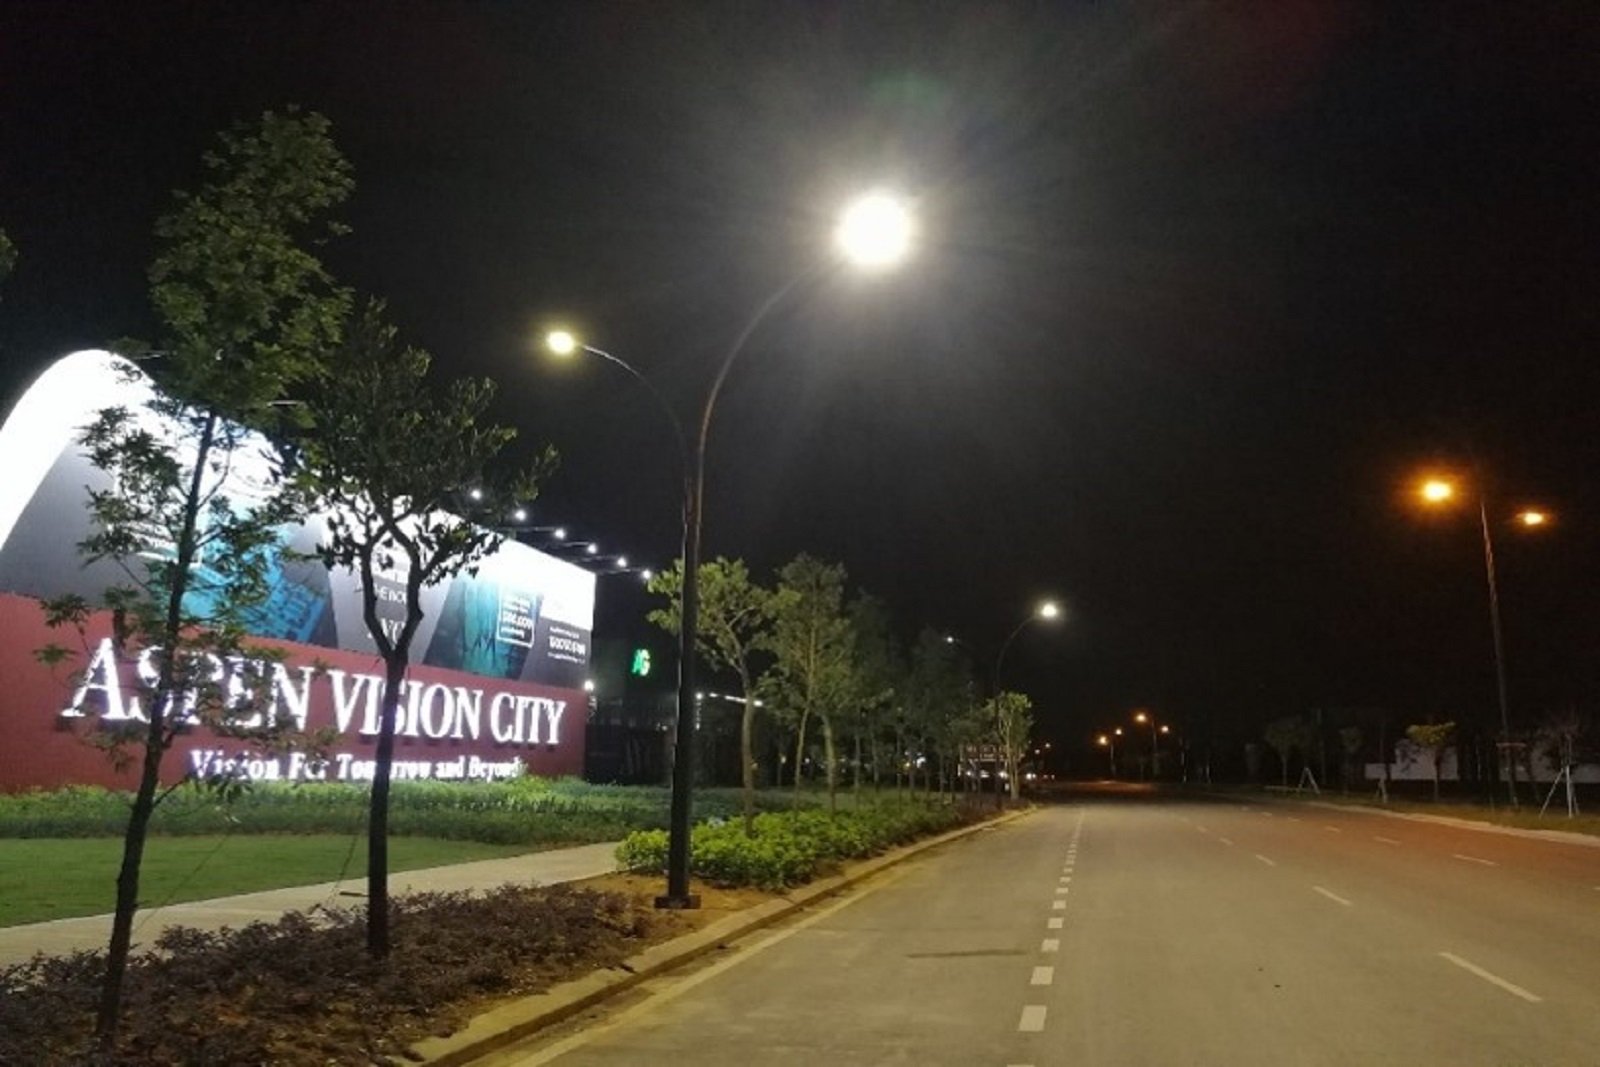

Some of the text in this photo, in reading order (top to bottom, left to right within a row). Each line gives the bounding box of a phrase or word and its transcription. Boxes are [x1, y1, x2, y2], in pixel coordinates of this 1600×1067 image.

[490, 691, 567, 745] CITY
[336, 753, 431, 780] Tomrrow
[435, 755, 466, 778] and
